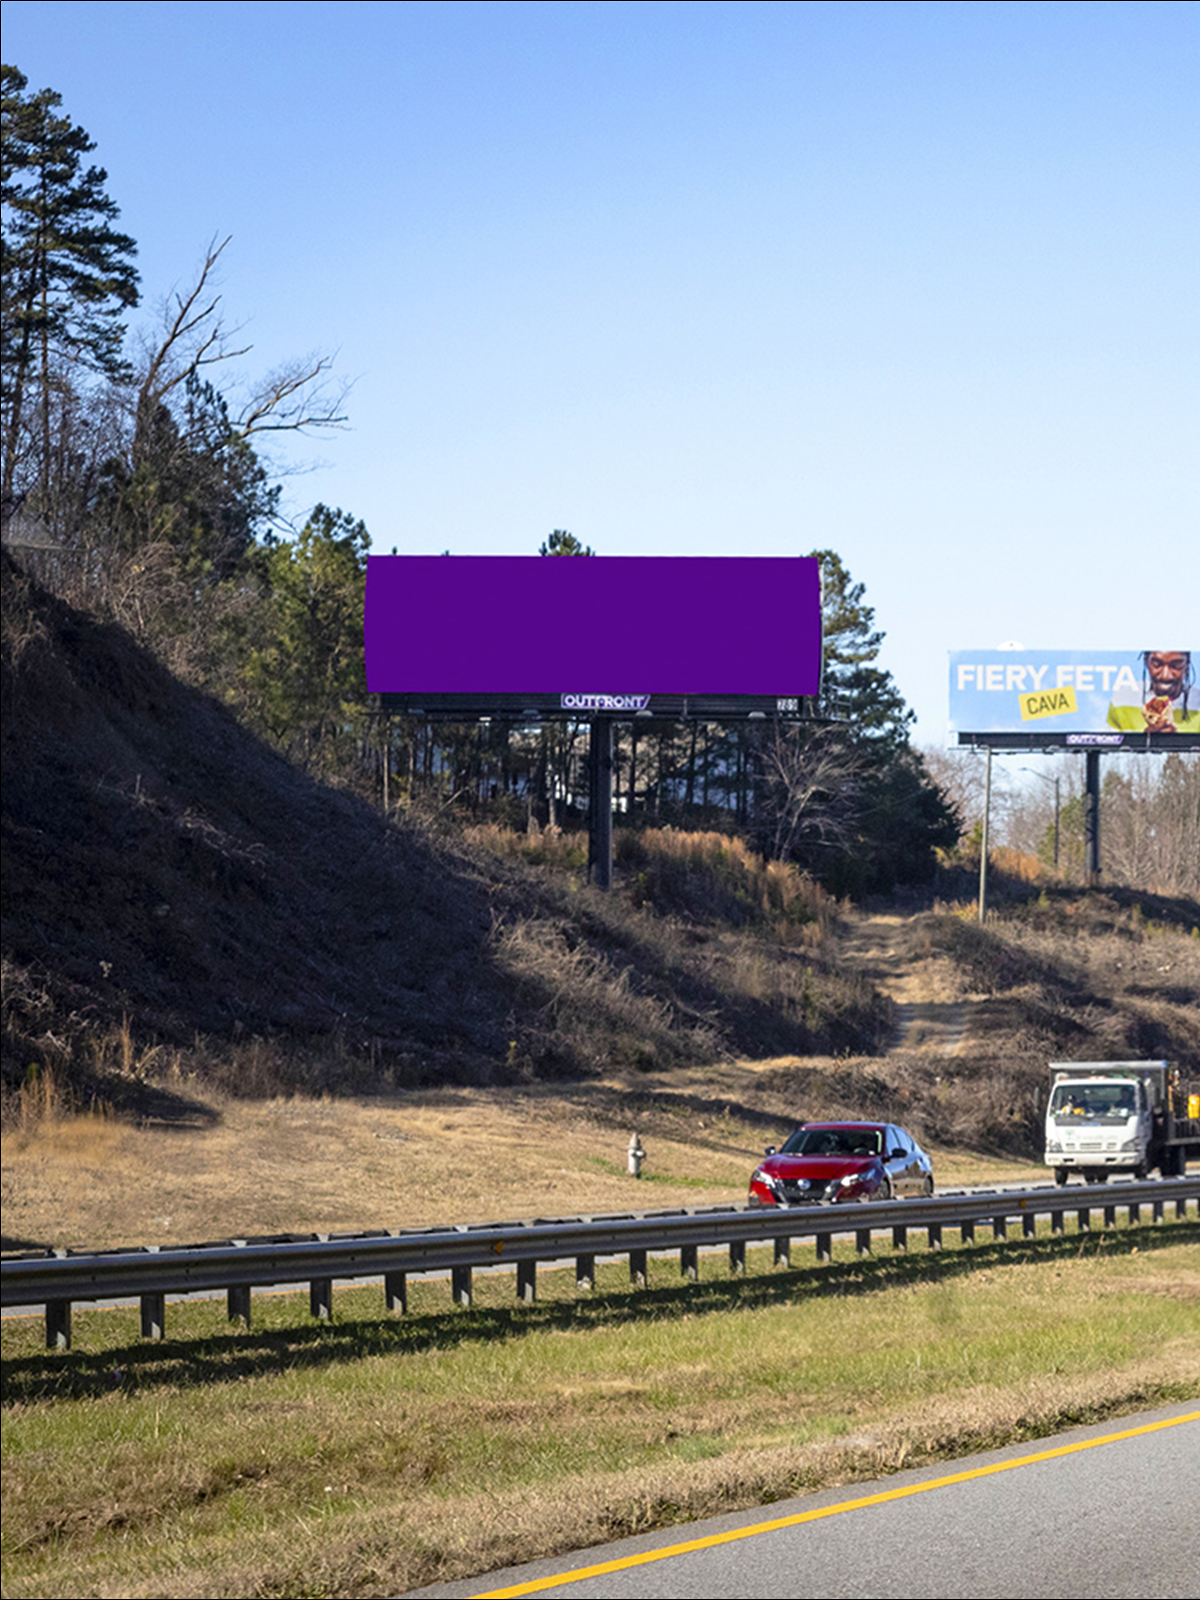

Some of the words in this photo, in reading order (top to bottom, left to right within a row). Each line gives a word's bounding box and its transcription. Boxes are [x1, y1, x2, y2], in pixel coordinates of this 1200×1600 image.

[957, 665, 1049, 691] FIERY
[1056, 665, 1139, 692] FETA
[564, 694, 645, 708] OUTFRONT
[1026, 693, 1070, 715] CAVA
